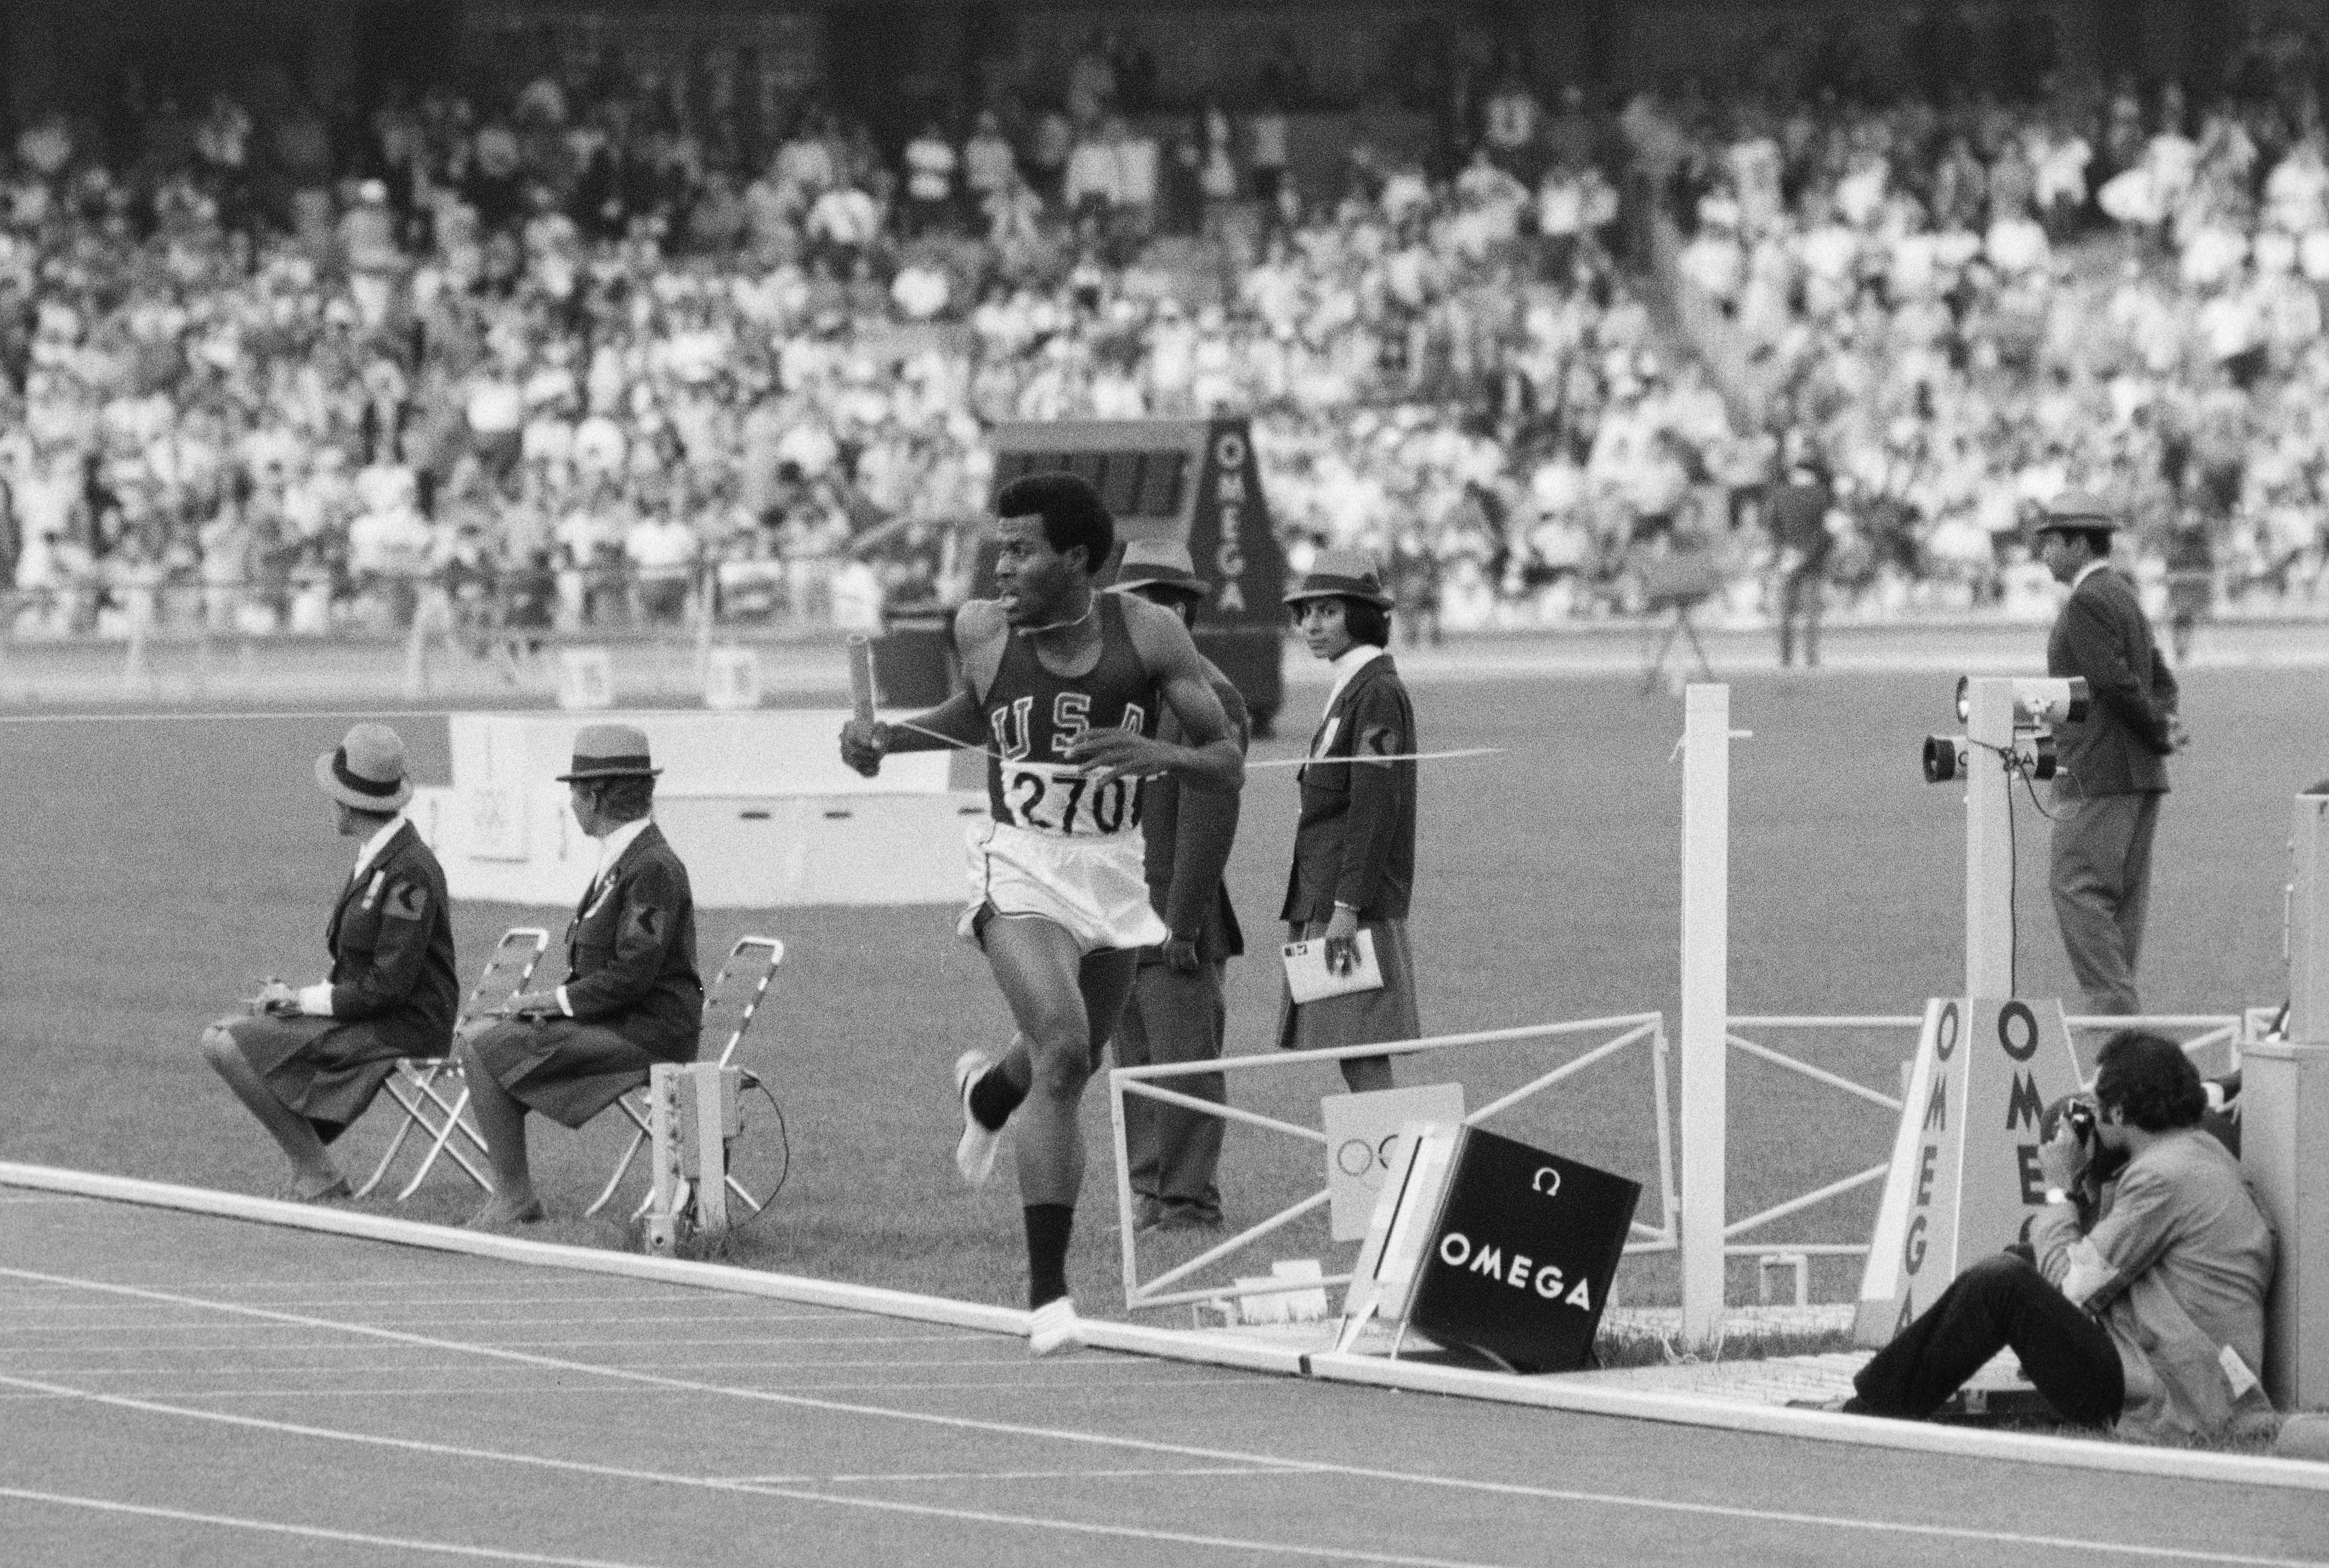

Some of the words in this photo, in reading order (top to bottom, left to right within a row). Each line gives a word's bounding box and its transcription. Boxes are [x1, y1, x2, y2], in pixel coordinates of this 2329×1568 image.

[1216, 433, 1246, 611] OMEGA
[991, 691, 1144, 761] USA
[1440, 1232, 1590, 1312] OMEGA
